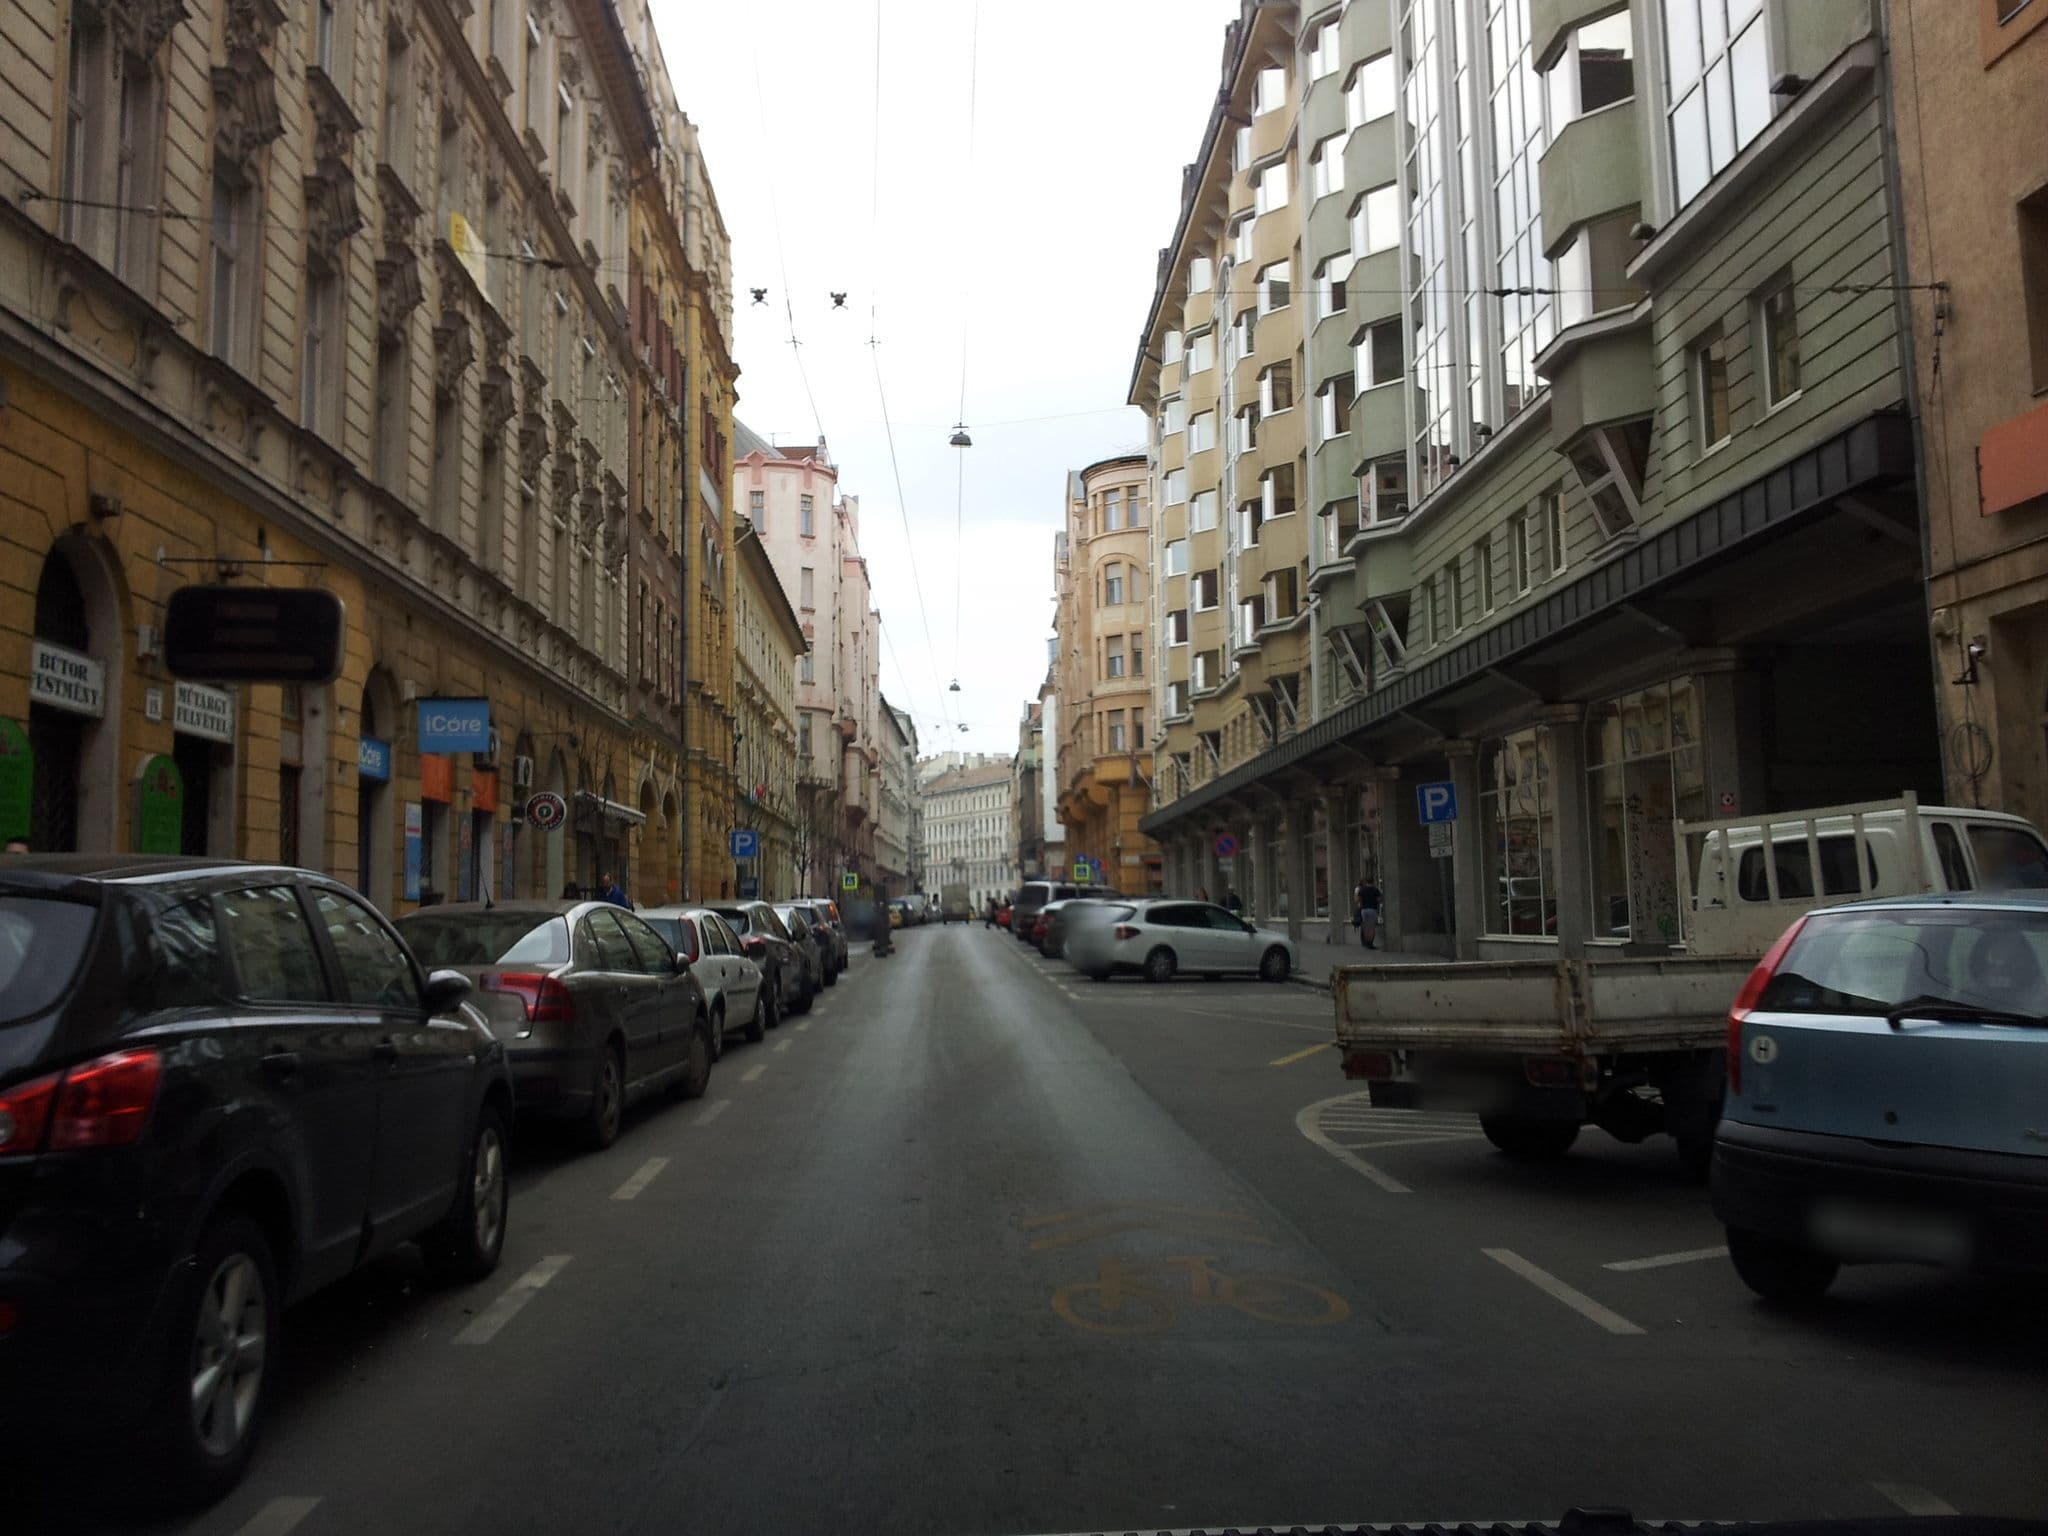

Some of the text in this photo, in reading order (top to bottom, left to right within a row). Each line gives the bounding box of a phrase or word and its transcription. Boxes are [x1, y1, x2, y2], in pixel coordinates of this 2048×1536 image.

[33, 673, 98, 706] ESTMÉNY
[1424, 786, 1449, 820] P
[735, 833, 752, 855] P
[1757, 1039, 1770, 1060] H
